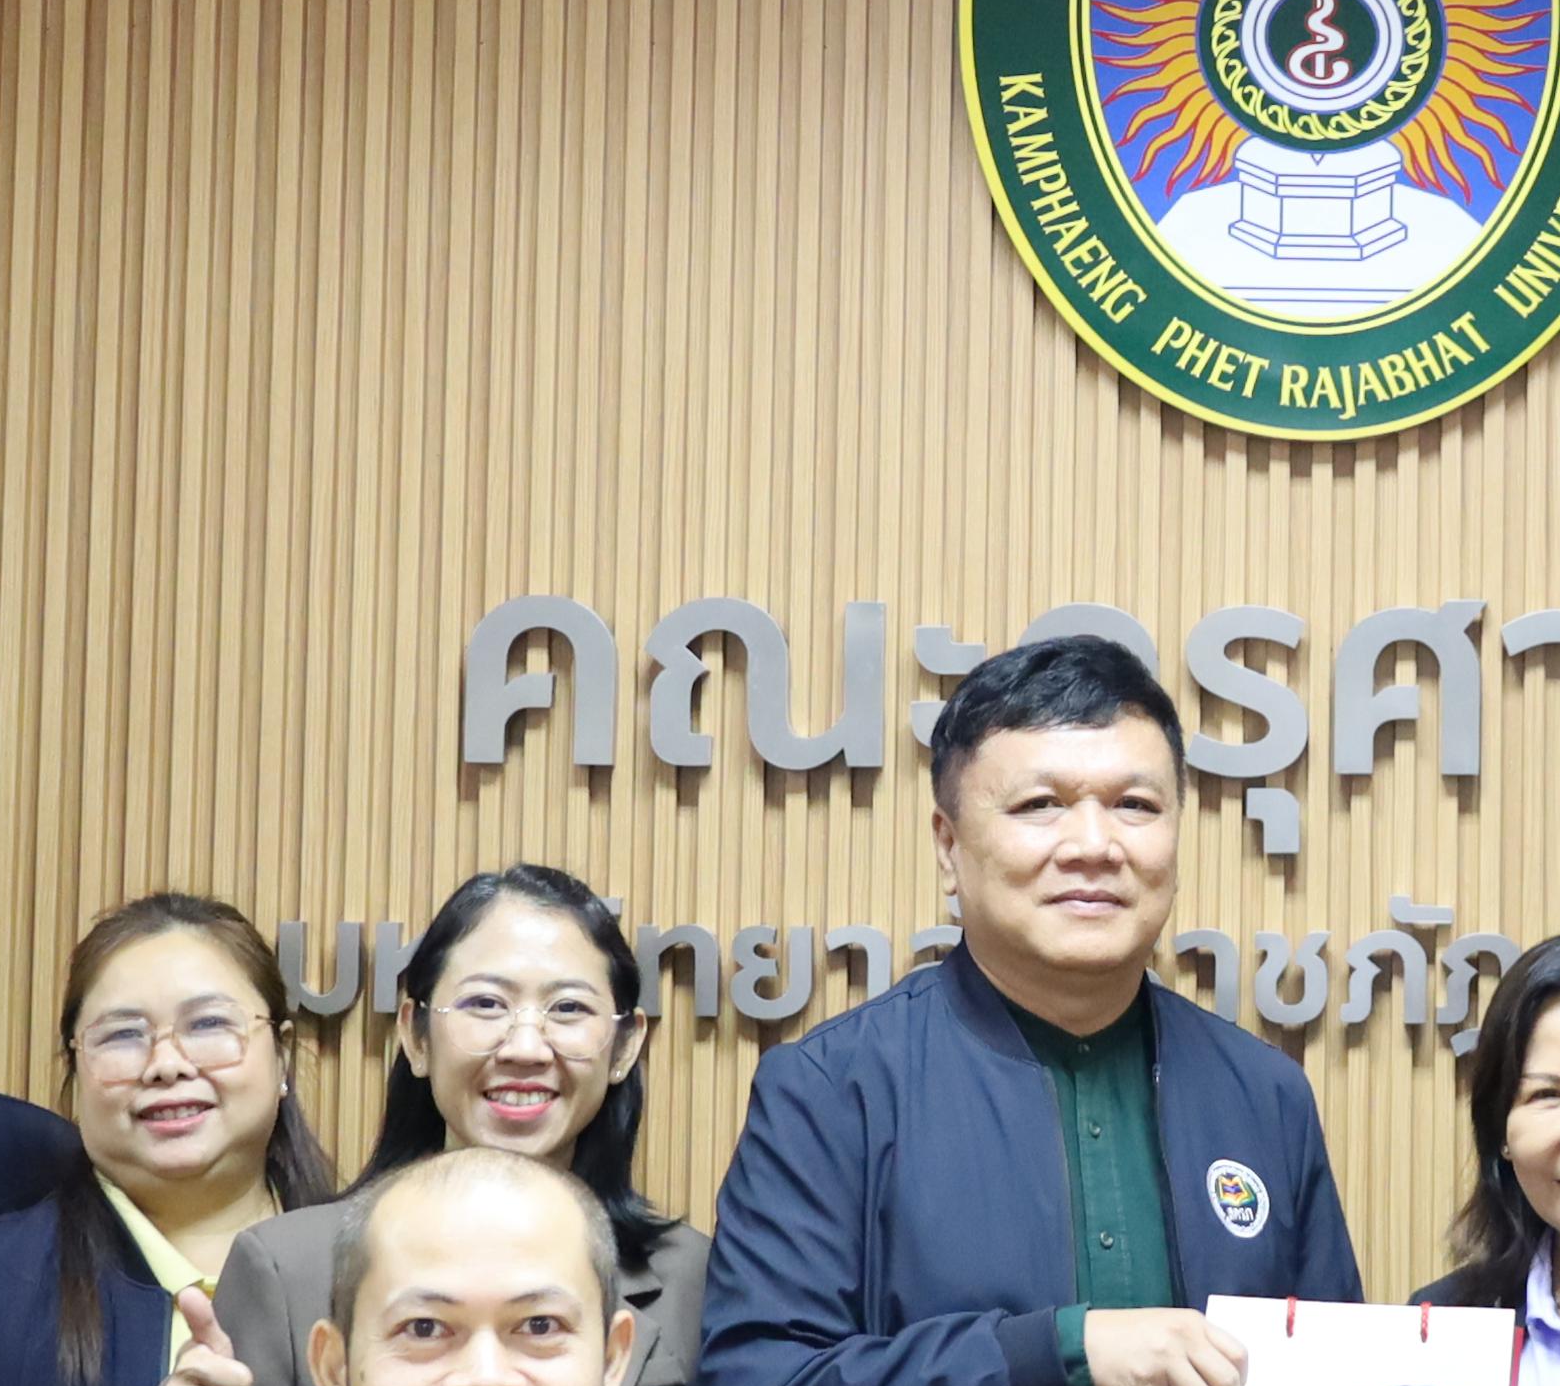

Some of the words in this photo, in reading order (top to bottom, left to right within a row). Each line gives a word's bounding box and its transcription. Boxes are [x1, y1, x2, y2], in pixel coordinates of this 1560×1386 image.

[1000, 73, 1146, 325] KAMPHAENG
[1152, 317, 1269, 398] PHET
[1280, 312, 1491, 420] RAJABHAT
